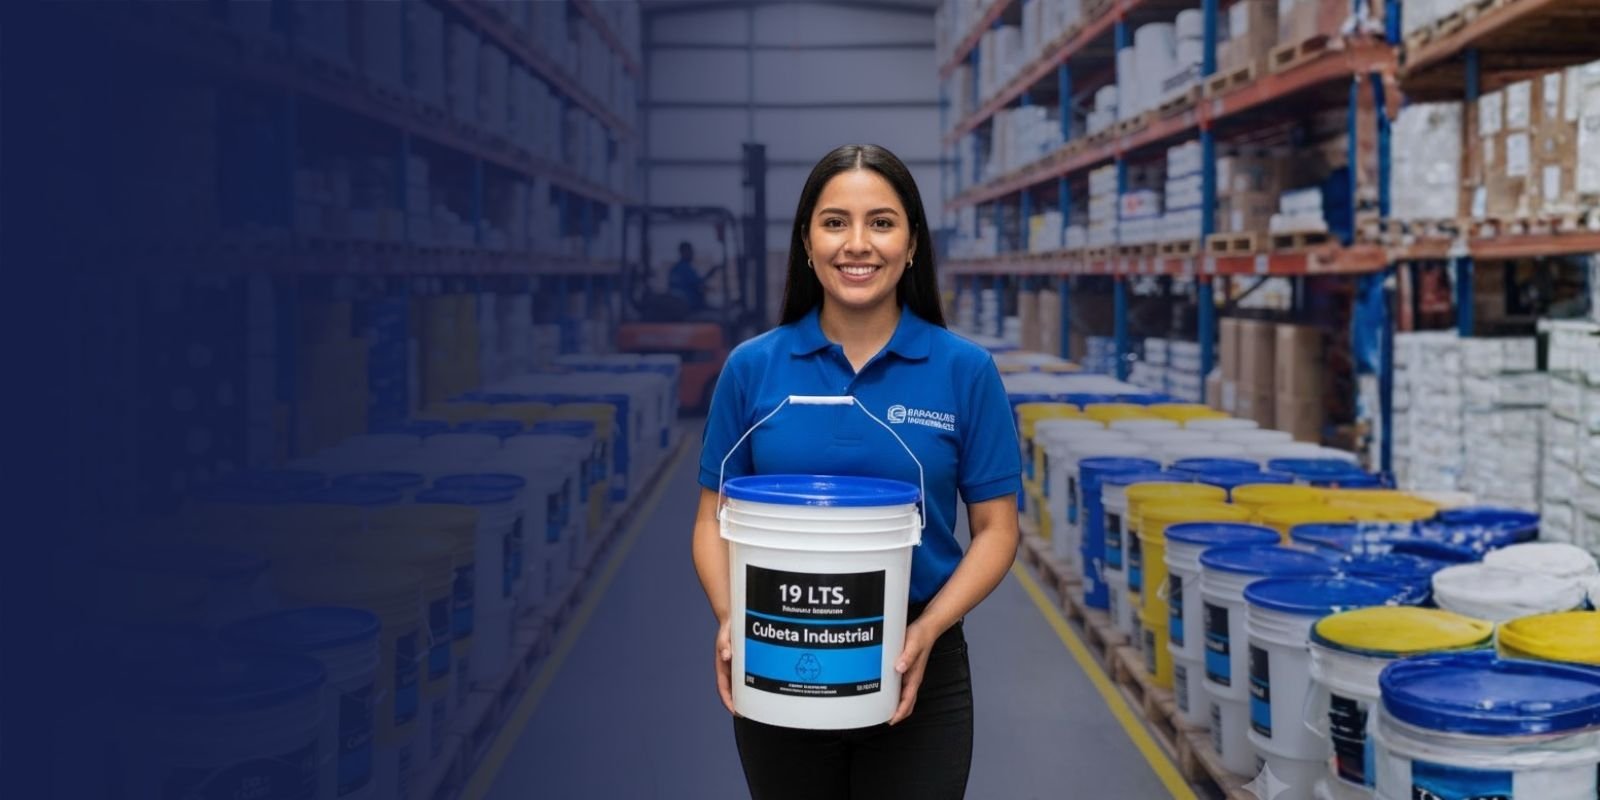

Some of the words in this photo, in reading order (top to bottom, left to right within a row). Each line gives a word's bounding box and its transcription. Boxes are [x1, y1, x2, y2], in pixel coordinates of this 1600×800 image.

[779, 583, 801, 603] 19
[808, 586, 850, 605] LTS.
[752, 621, 800, 642] Cubeta
[804, 626, 874, 644] Industrial
